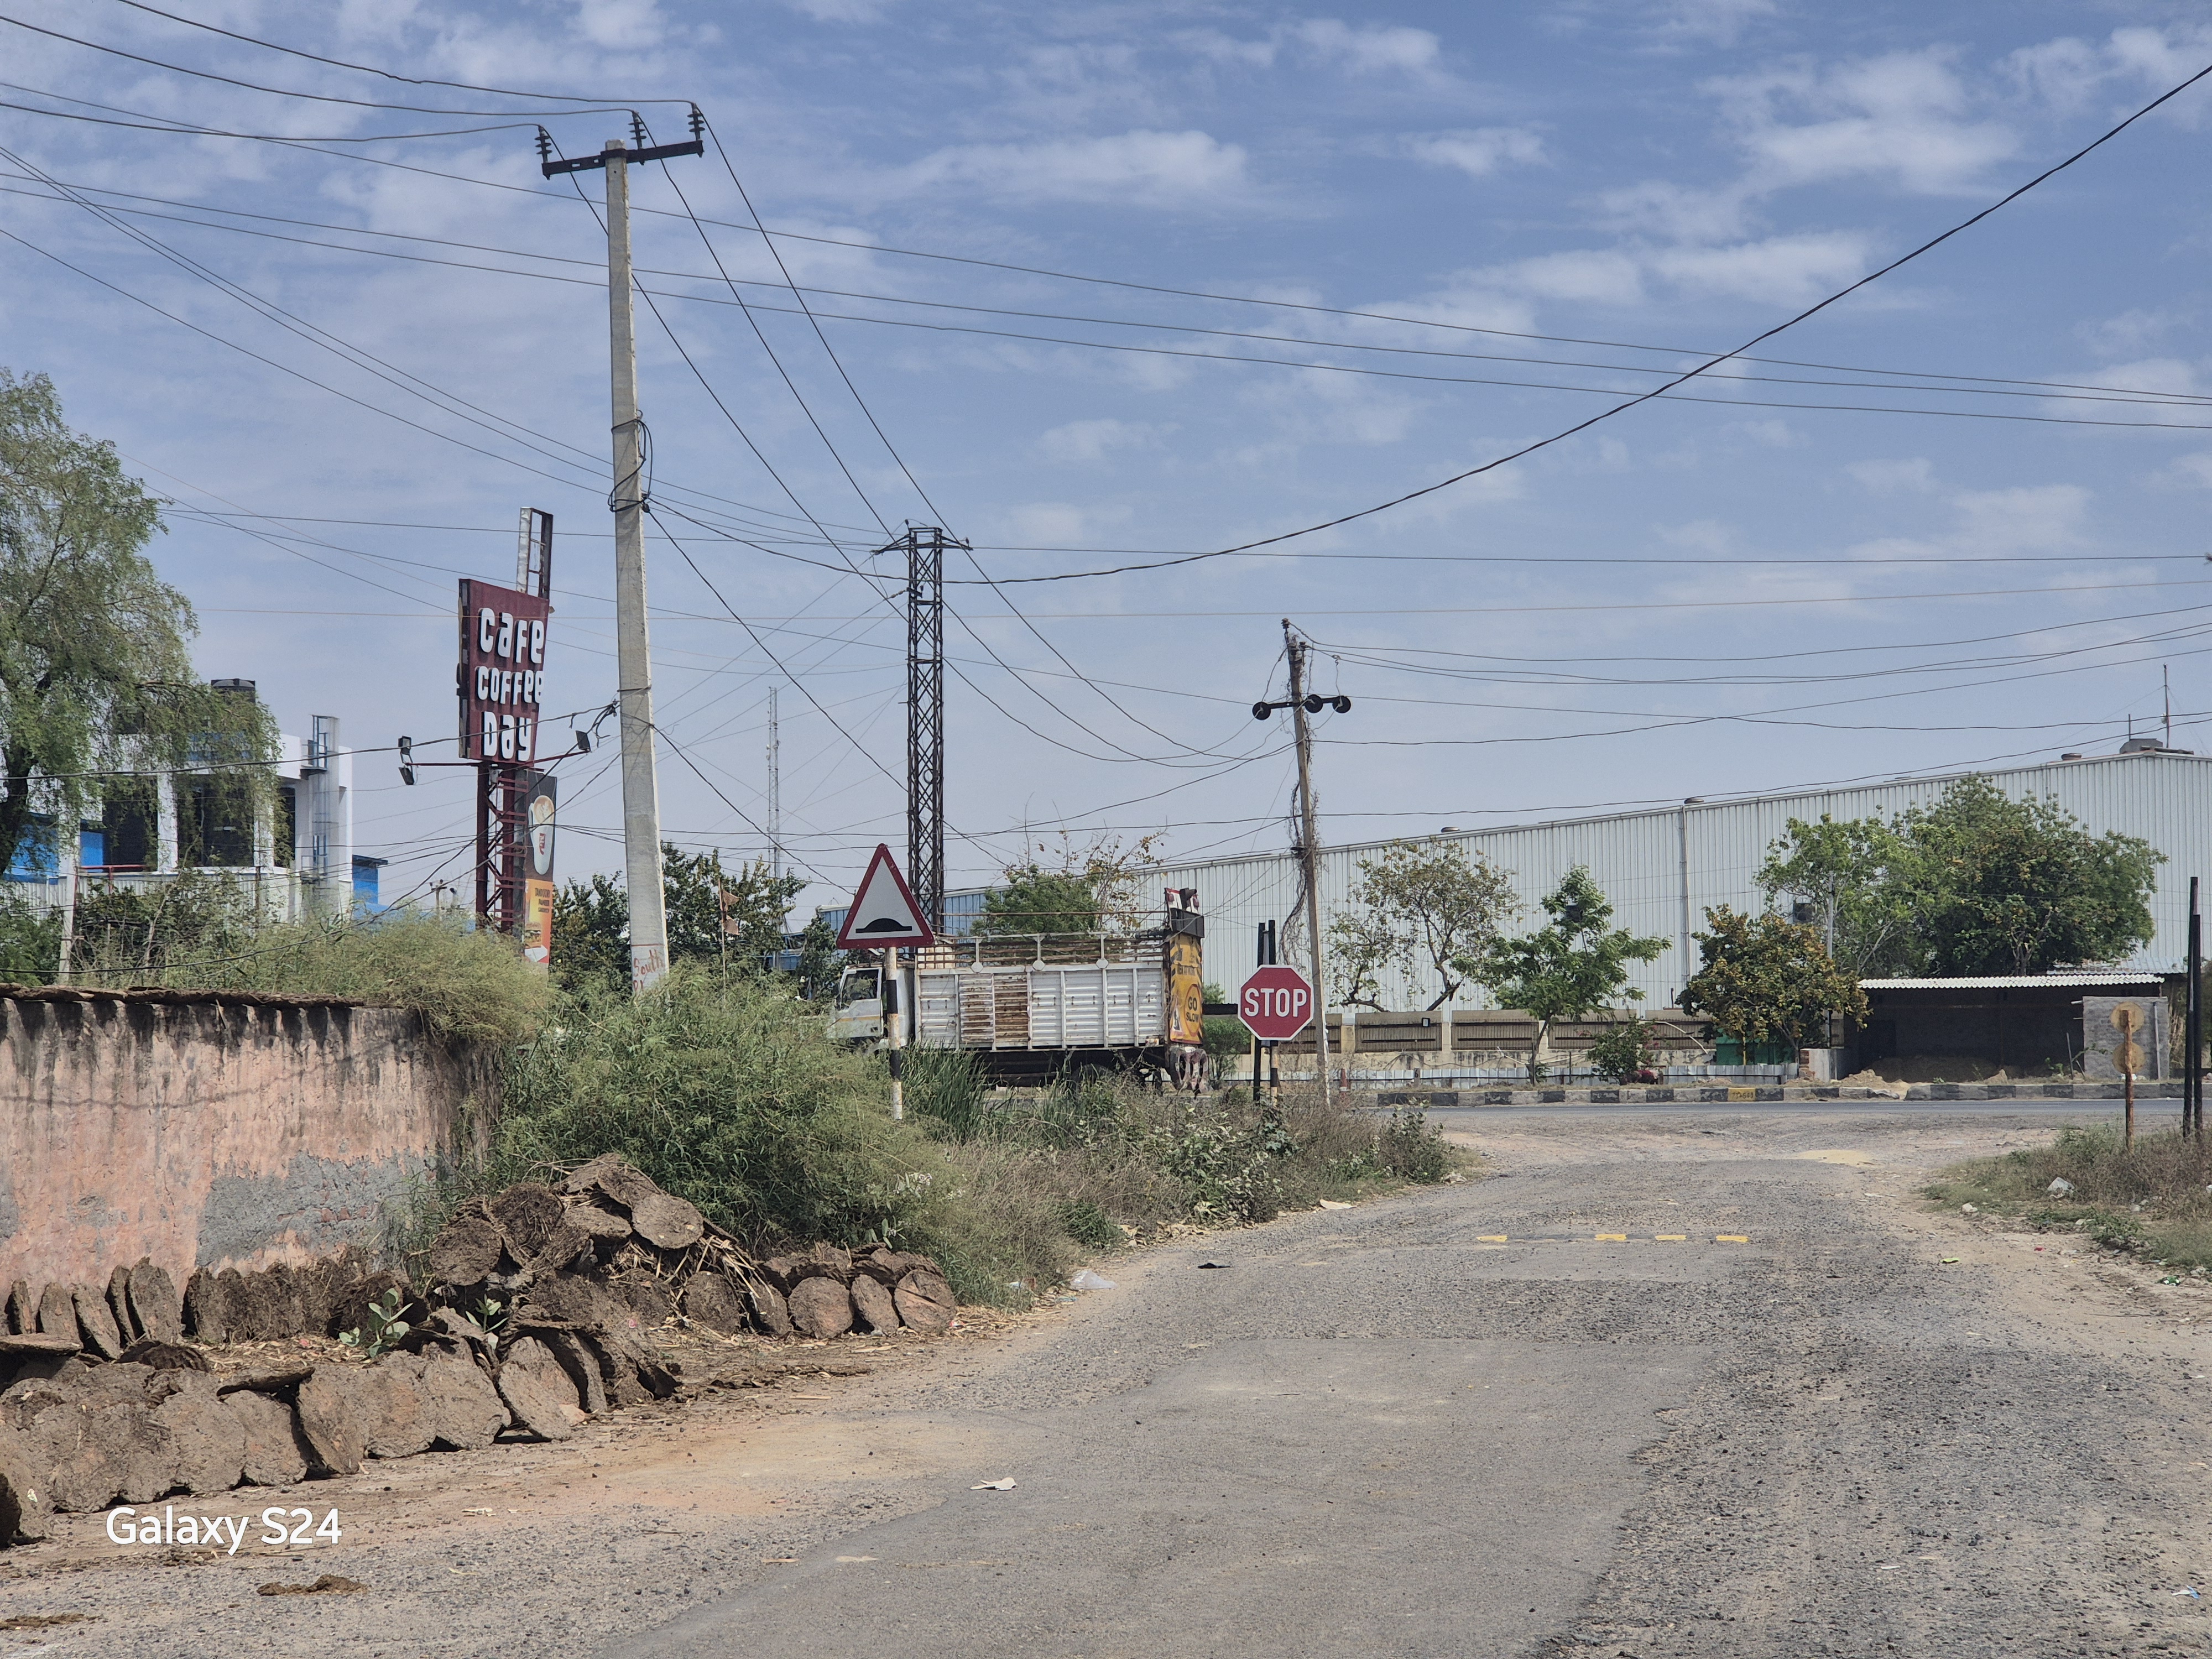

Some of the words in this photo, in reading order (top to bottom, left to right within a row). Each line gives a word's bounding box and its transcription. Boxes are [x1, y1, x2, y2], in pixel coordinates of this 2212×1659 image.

[482, 711, 531, 762] Day
[1188, 996, 1197, 1011] GO
[1244, 988, 1307, 1017] STOP
[1186, 1012, 1199, 1022] SLOW
